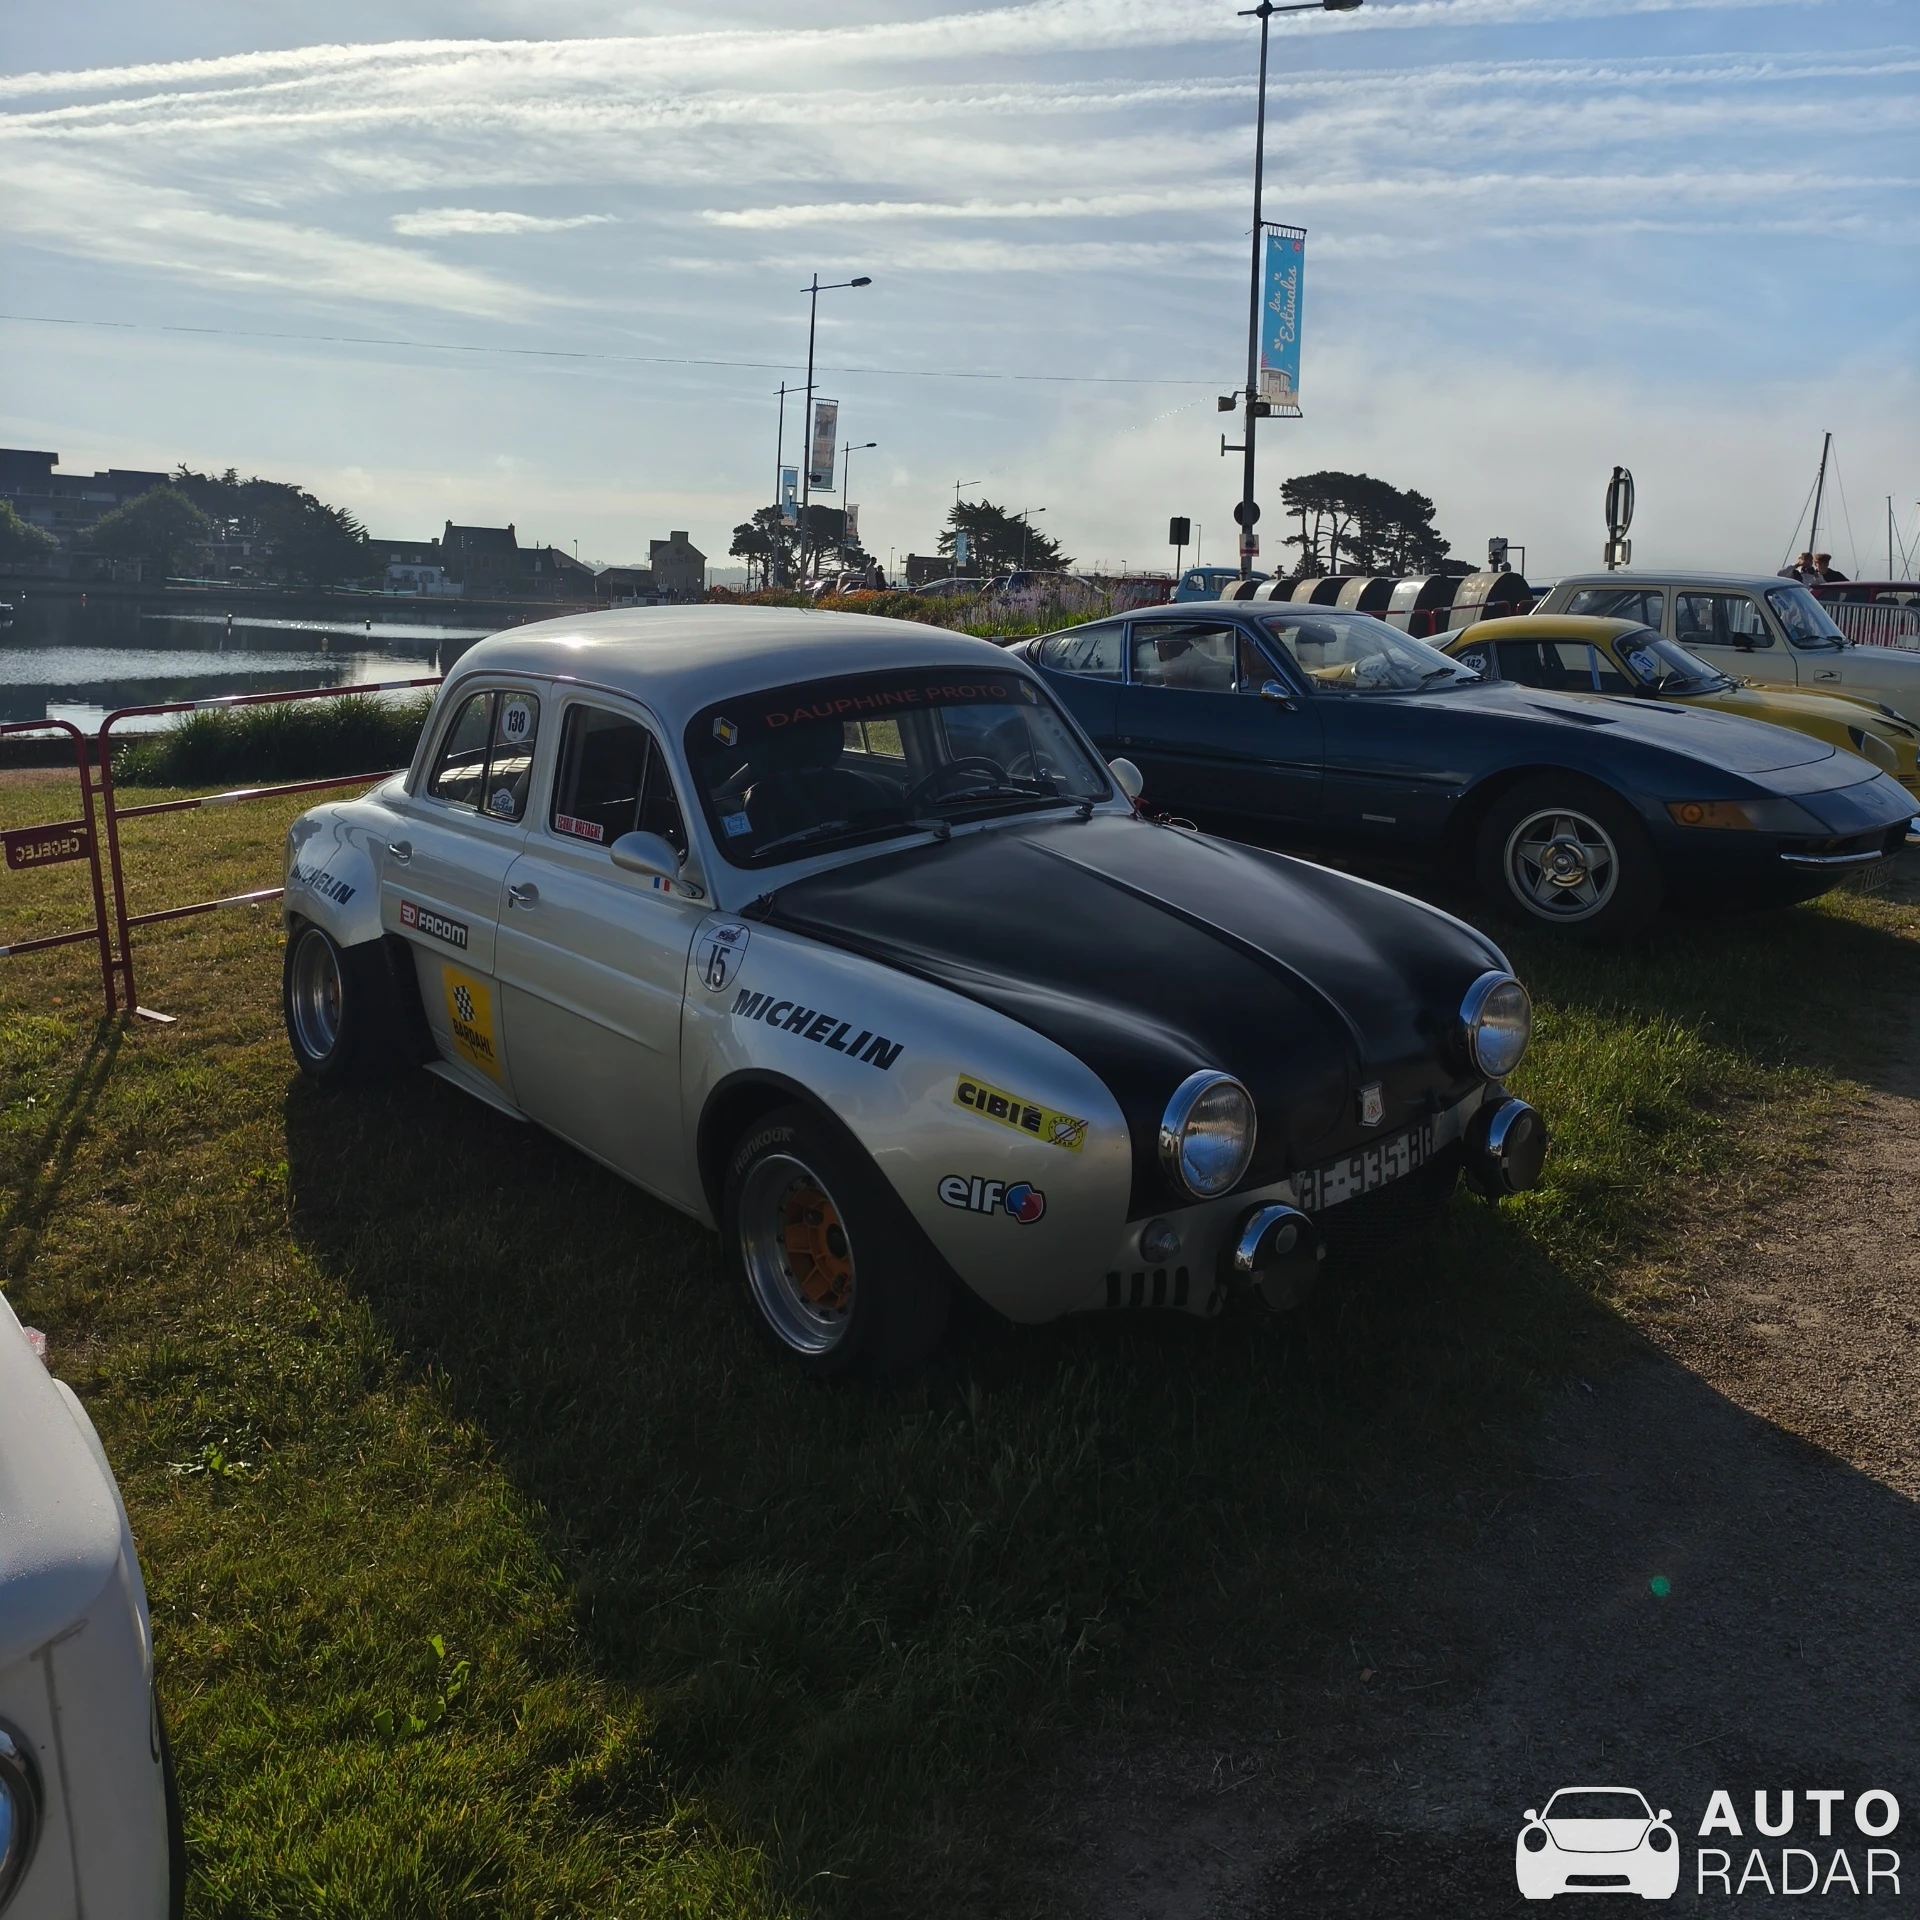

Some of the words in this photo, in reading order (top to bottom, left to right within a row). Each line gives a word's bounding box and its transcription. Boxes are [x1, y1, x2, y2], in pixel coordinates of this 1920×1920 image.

[1279, 265, 1298, 343] Estivales
[1466, 659, 1481, 668] 142
[508, 710, 525, 733] 138
[765, 689, 921, 728] DAUPHINE
[925, 685, 1007, 700] PROTO
[557, 815, 573, 831] ECURIE
[575, 820, 601, 838] BRETAGNE
[290, 862, 356, 905] MICHELIN
[418, 912, 466, 945] FACOM
[705, 944, 730, 988] 15
[452, 1017, 494, 1059] BARDAHL
[730, 989, 904, 1071] MICHELIN
[937, 1175, 1004, 1214] elf
